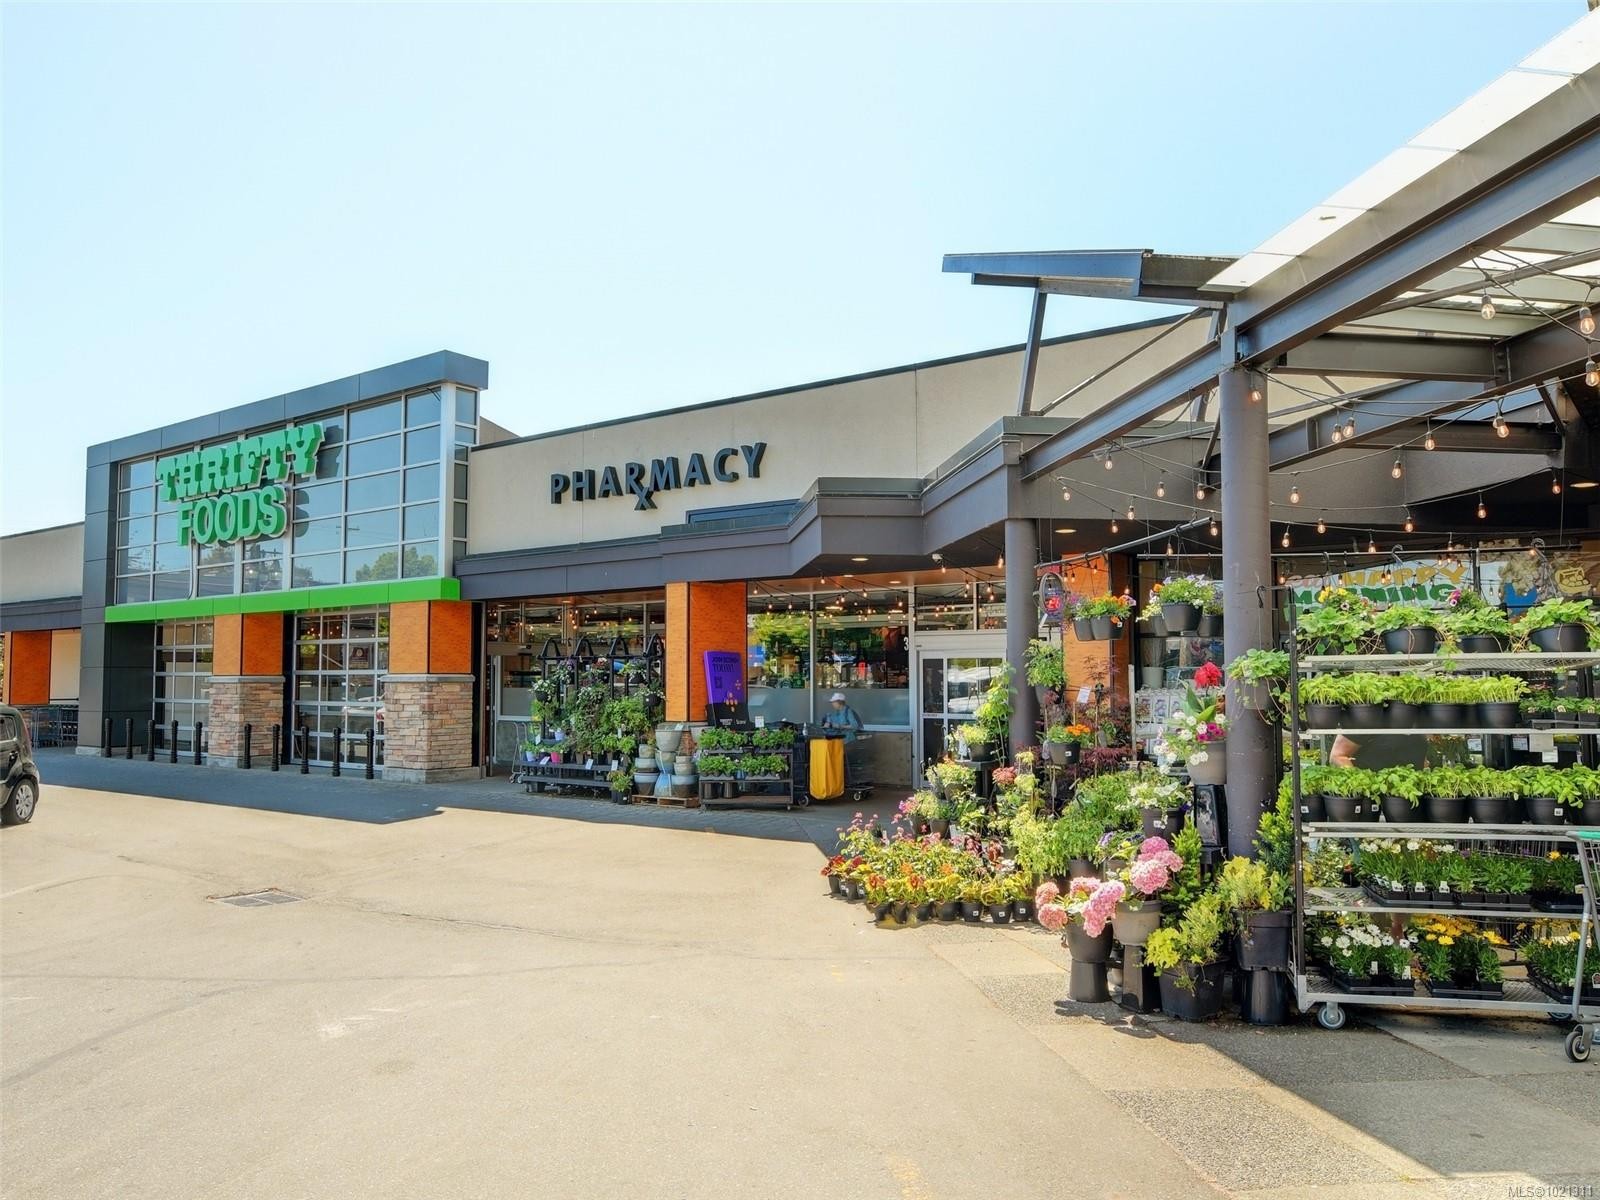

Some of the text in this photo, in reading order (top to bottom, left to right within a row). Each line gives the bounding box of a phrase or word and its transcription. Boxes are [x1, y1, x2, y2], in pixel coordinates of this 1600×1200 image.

[157, 423, 326, 502] THRIFTY
[550, 441, 766, 510] PHARMACY
[178, 485, 289, 546] FOODS
[1291, 584, 1458, 605] MNING
[1343, 567, 1468, 586] HAPPY
